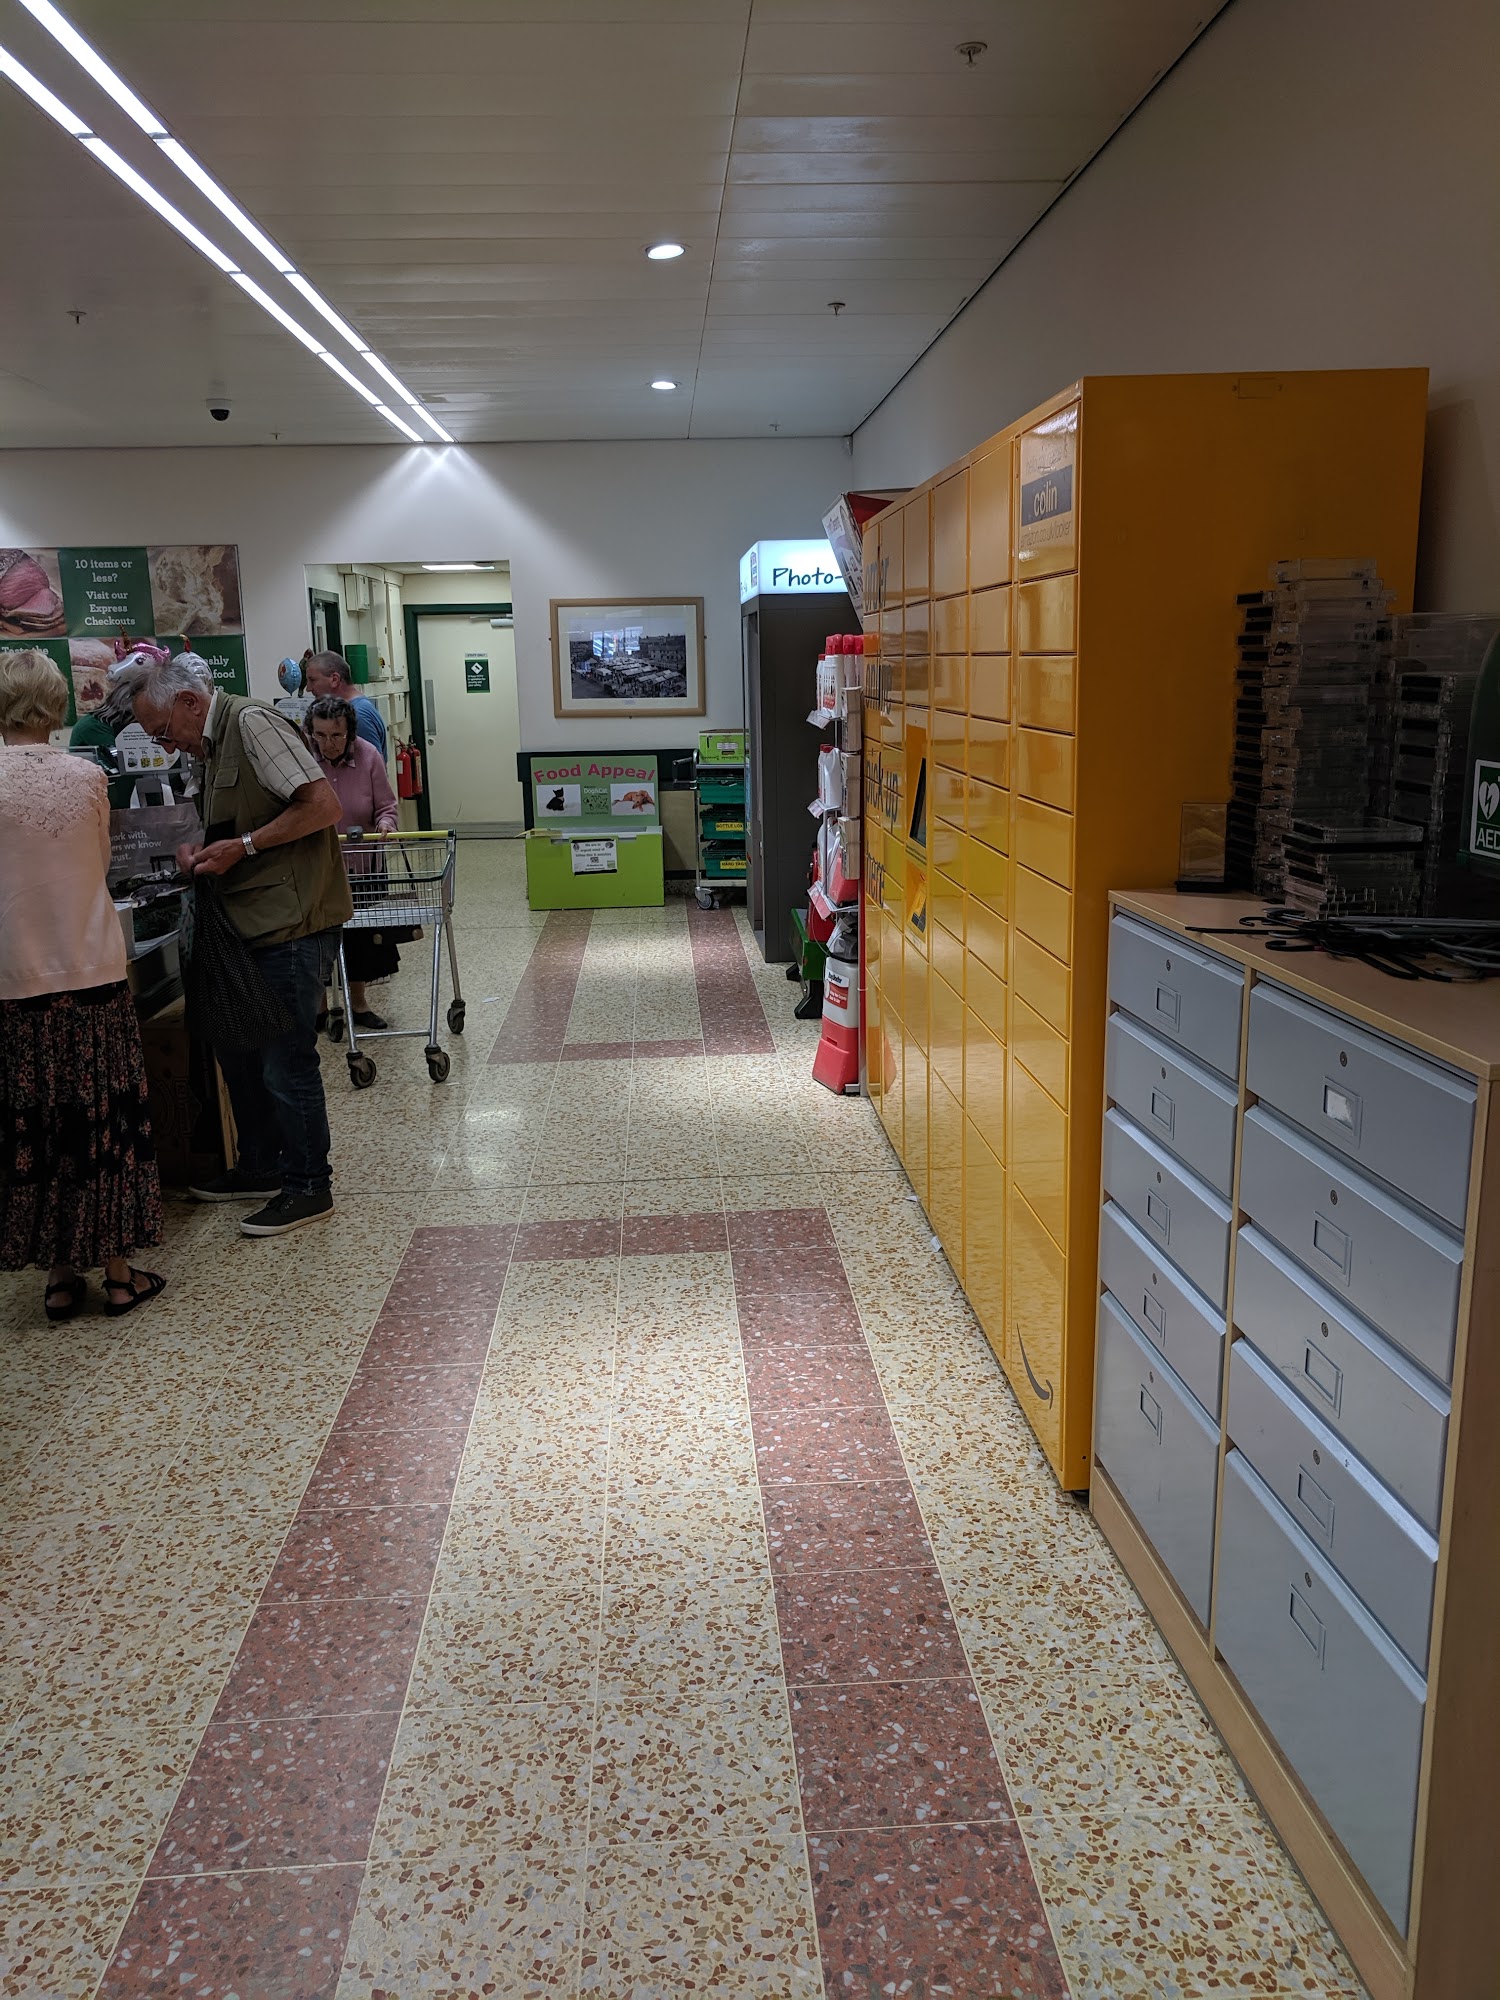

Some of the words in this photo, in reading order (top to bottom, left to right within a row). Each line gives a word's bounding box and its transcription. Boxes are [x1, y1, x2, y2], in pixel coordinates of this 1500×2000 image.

[1034, 480, 1057, 517] colin
[75, 559, 88, 569] 10
[90, 559, 119, 569] items
[121, 561, 132, 569] or
[92, 572, 118, 583] less?
[86, 590, 110, 600] Visit
[111, 592, 128, 600] our
[89, 604, 128, 614] Express
[84, 616, 136, 626] Checkouts
[213, 668, 236, 679] food
[533, 764, 582, 783] Food
[588, 763, 656, 781] Appeal
[886, 770, 898, 834] up
[128, 830, 147, 839] with
[138, 840, 162, 849] know
